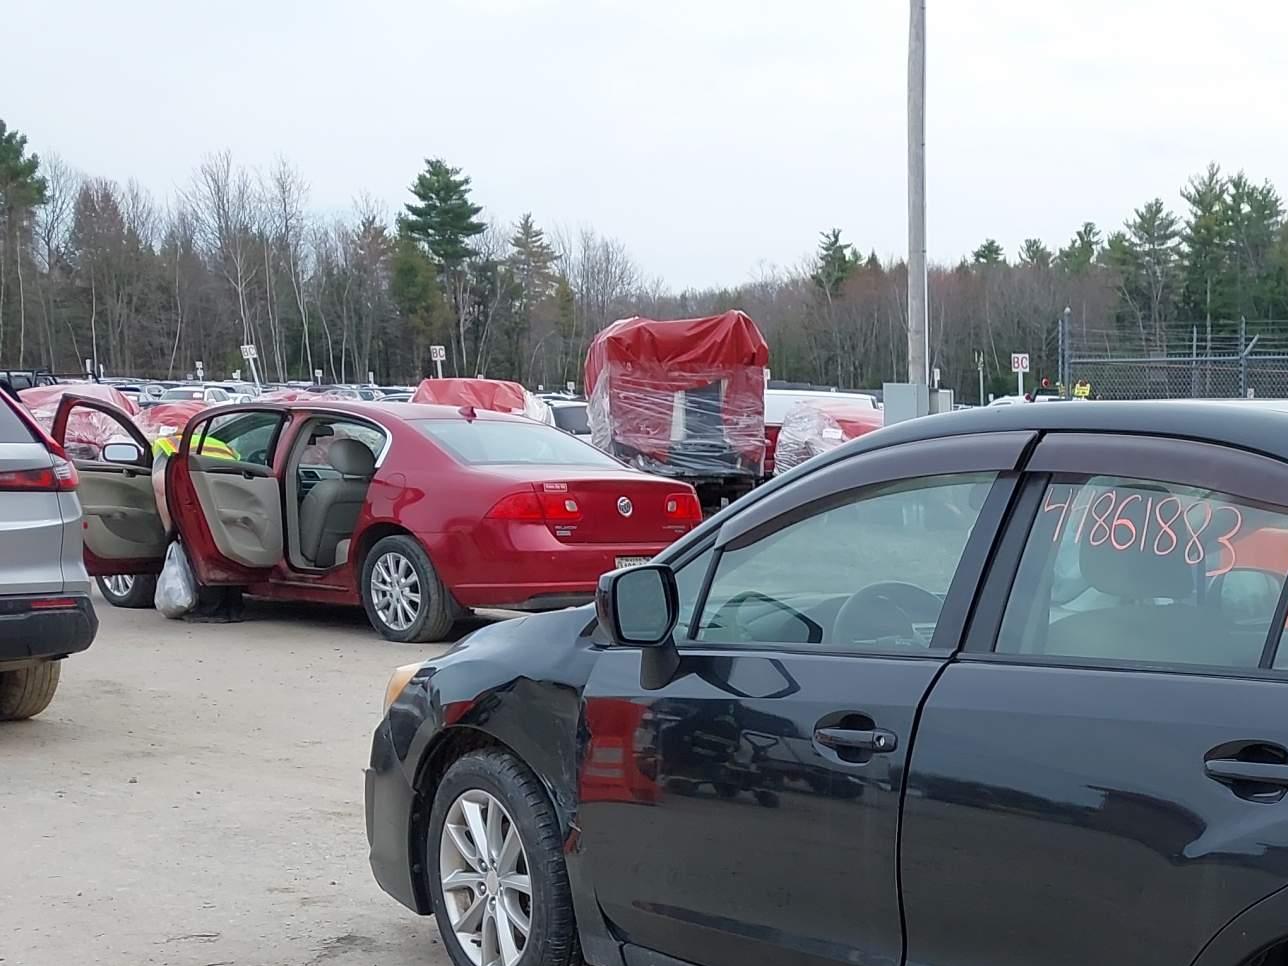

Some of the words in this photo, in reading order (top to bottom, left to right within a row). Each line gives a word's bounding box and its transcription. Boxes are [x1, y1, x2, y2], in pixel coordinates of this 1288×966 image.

[241, 346, 256, 356] BC
[431, 347, 445, 358] BC
[1012, 356, 1028, 369] BC
[1044, 486, 1242, 577] 44861883
